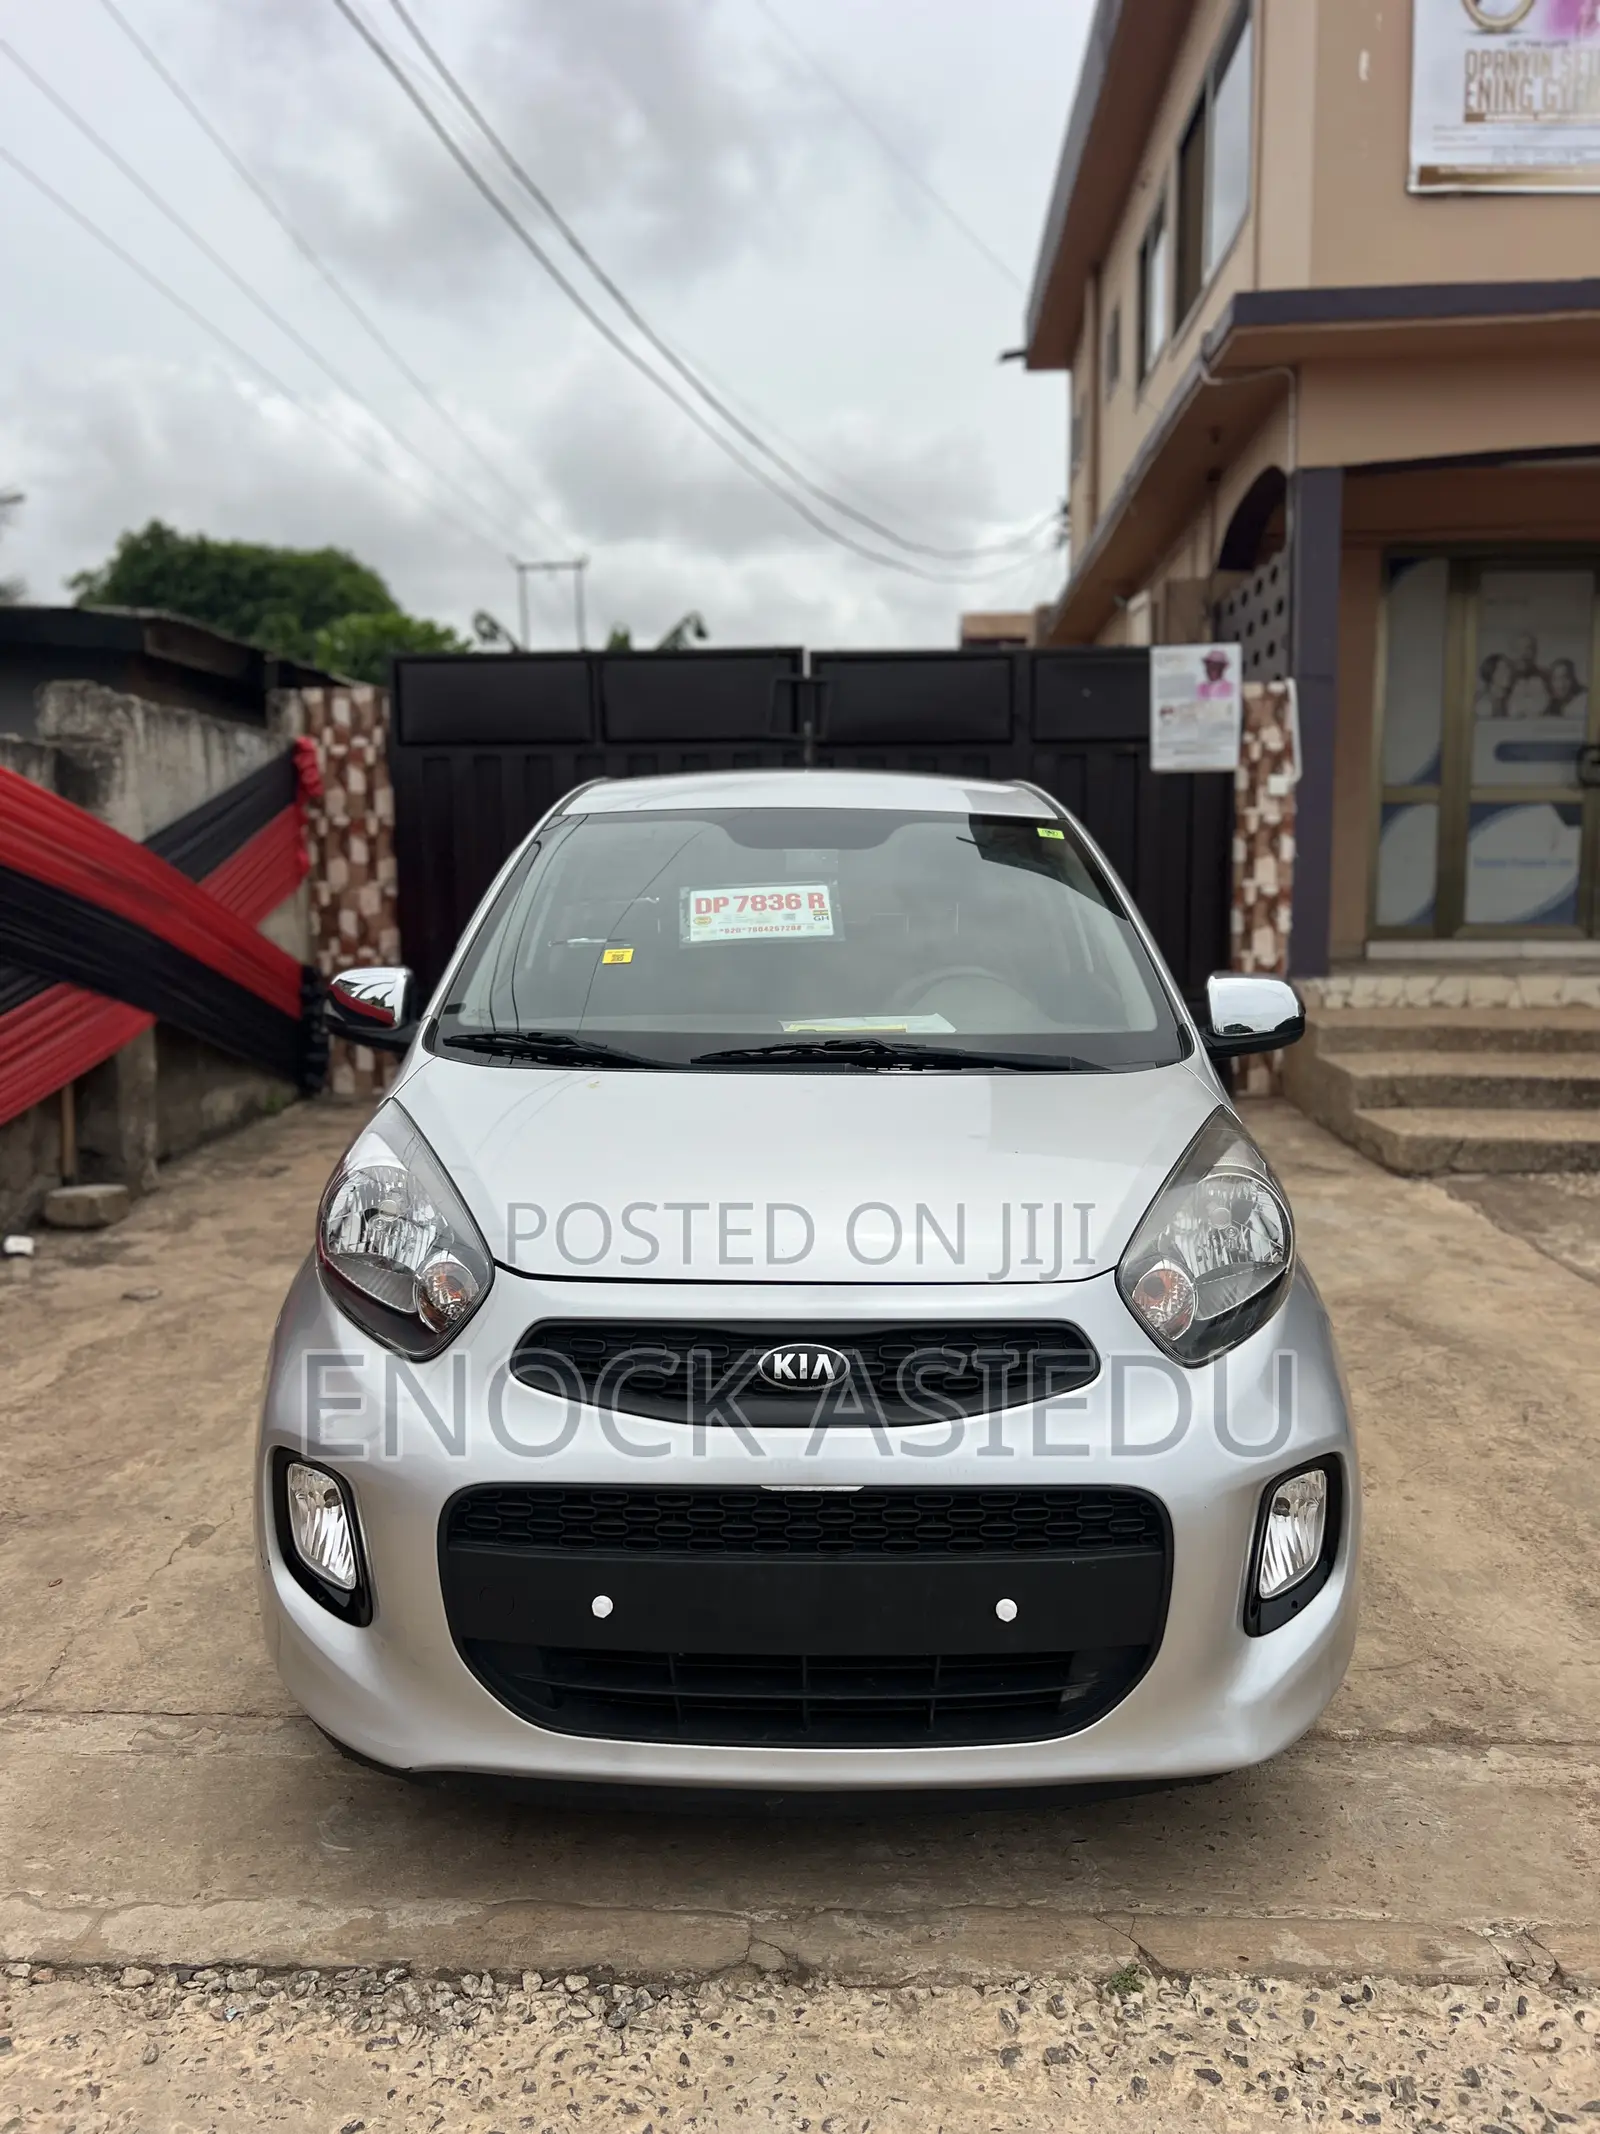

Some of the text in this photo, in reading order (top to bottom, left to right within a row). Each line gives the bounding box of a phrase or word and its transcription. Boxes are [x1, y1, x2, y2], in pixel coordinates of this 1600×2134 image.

[1464, 78, 1534, 113] ENING
[695, 892, 825, 914] DP 7836 R
[773, 1353, 836, 1380] KIA
